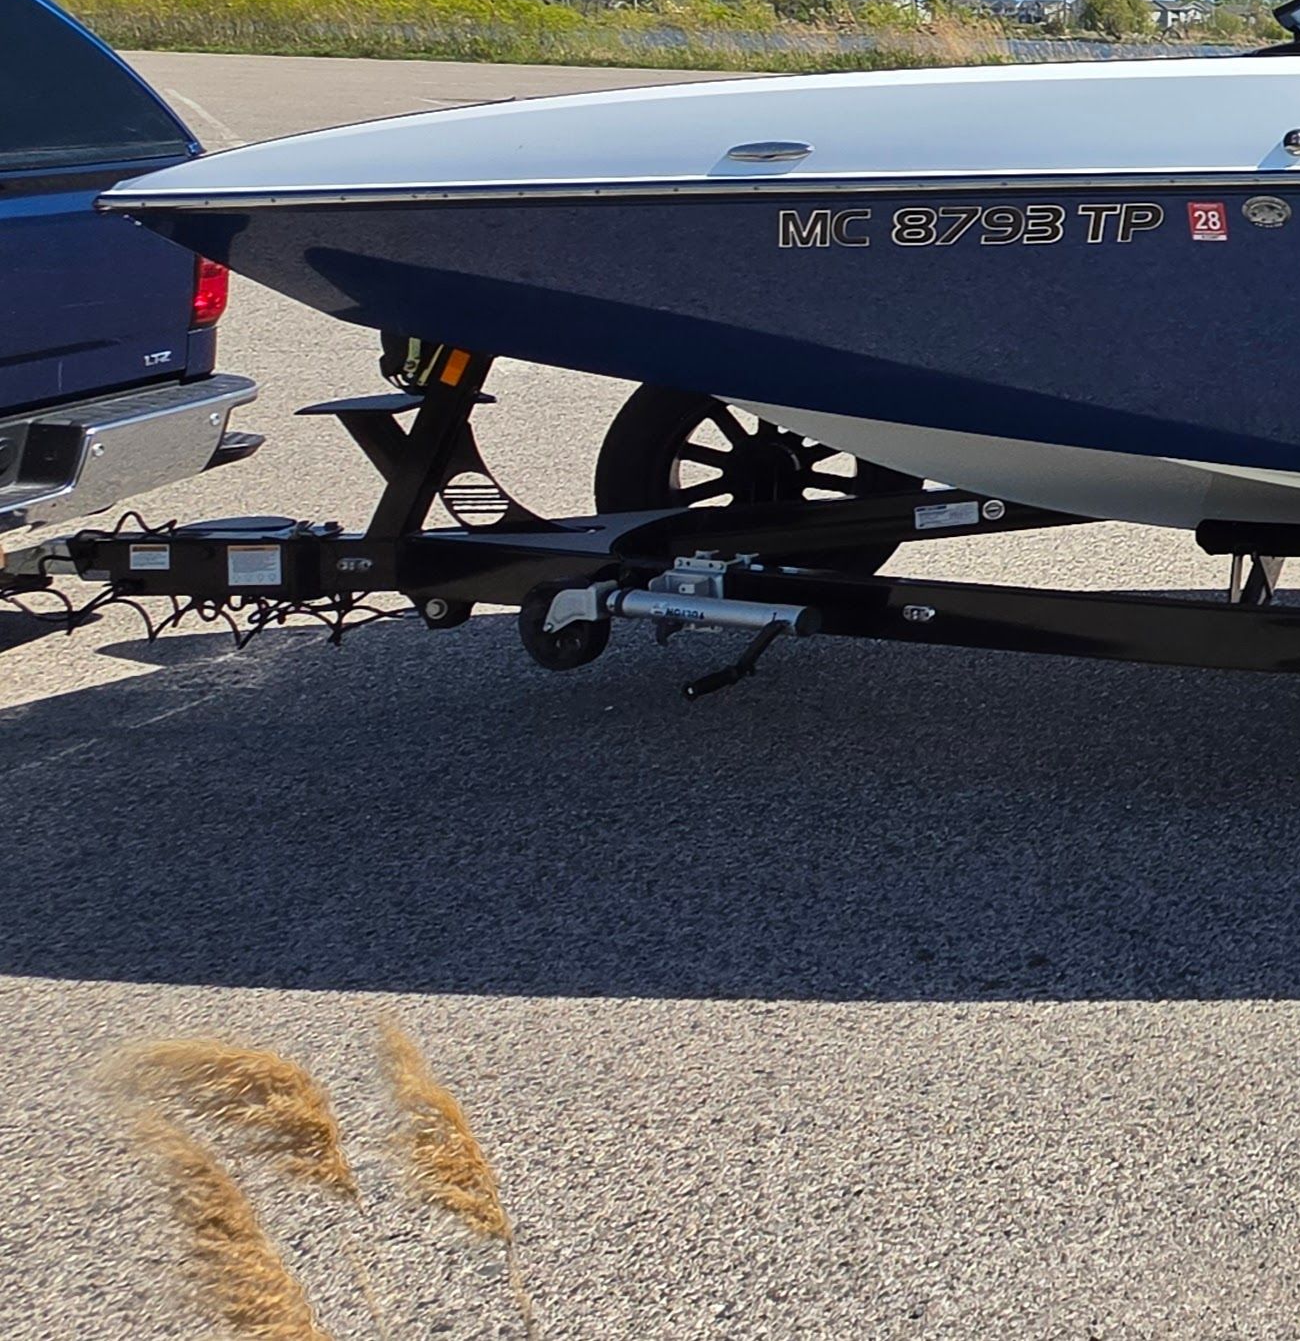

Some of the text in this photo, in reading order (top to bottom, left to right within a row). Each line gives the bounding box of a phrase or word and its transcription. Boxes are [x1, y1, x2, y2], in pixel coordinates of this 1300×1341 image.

[778, 202, 1165, 248] MC 8793 TP
[1193, 210, 1221, 230] 28
[144, 350, 172, 366] LTZ
